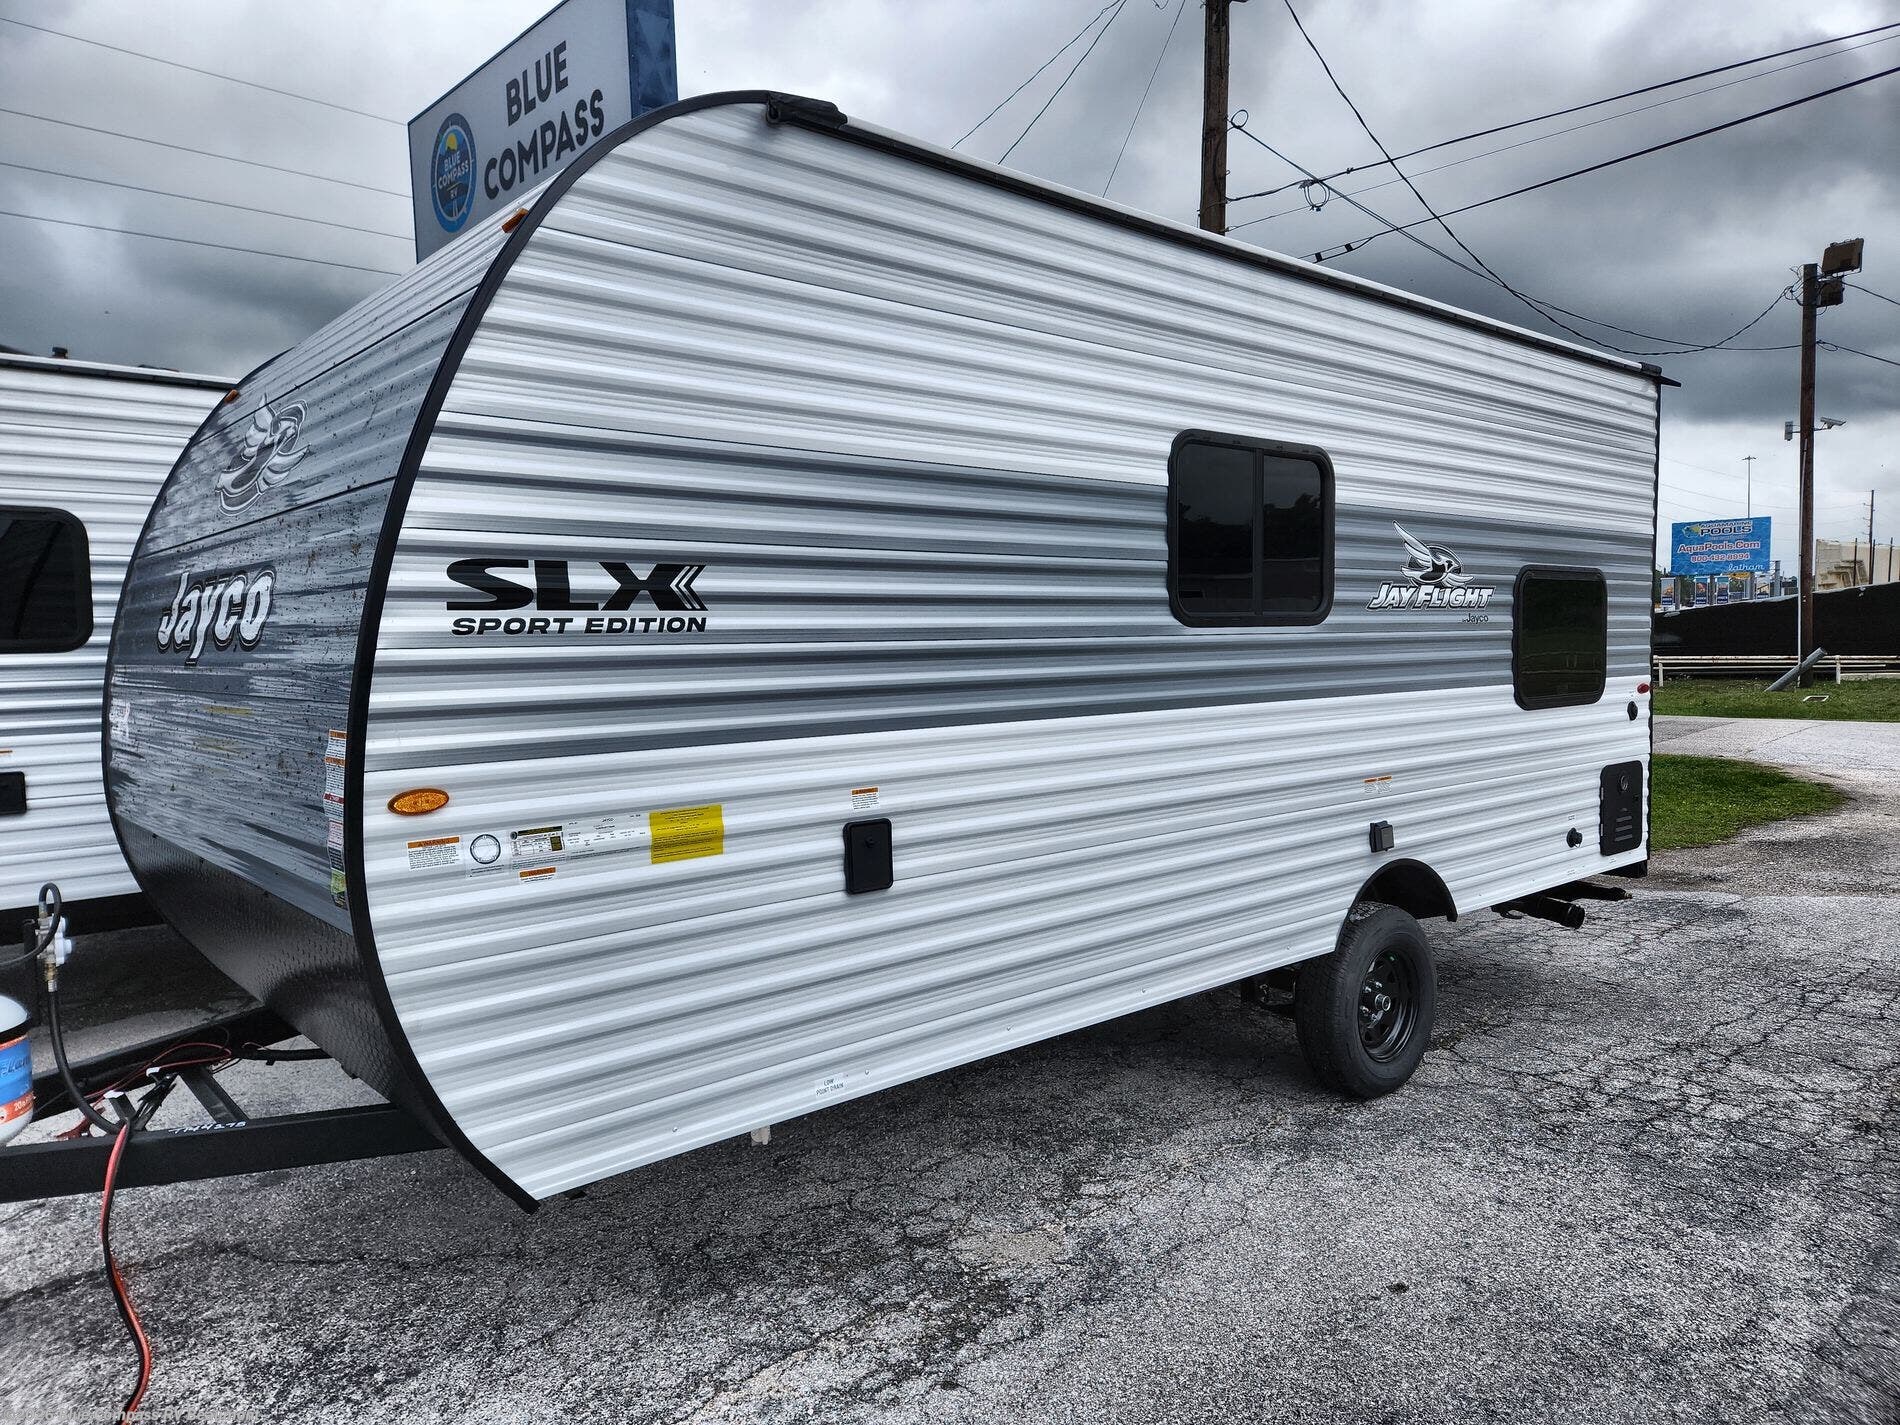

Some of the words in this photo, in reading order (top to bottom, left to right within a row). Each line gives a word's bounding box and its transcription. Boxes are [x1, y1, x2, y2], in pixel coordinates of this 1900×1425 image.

[505, 40, 569, 126] BLUE
[483, 88, 605, 200] COMPASS
[438, 160, 469, 189] COMPASS
[444, 151, 461, 171] BLUE
[1700, 525, 1752, 536] POOLS
[1678, 540, 1760, 554] AquaPools.Com
[446, 558, 709, 611] SLX
[1367, 582, 1417, 609] JAY
[1412, 584, 1496, 609] FLIGHT
[157, 566, 276, 664] Jayco
[451, 617, 573, 635] SPORT
[584, 617, 707, 634] EDITION
